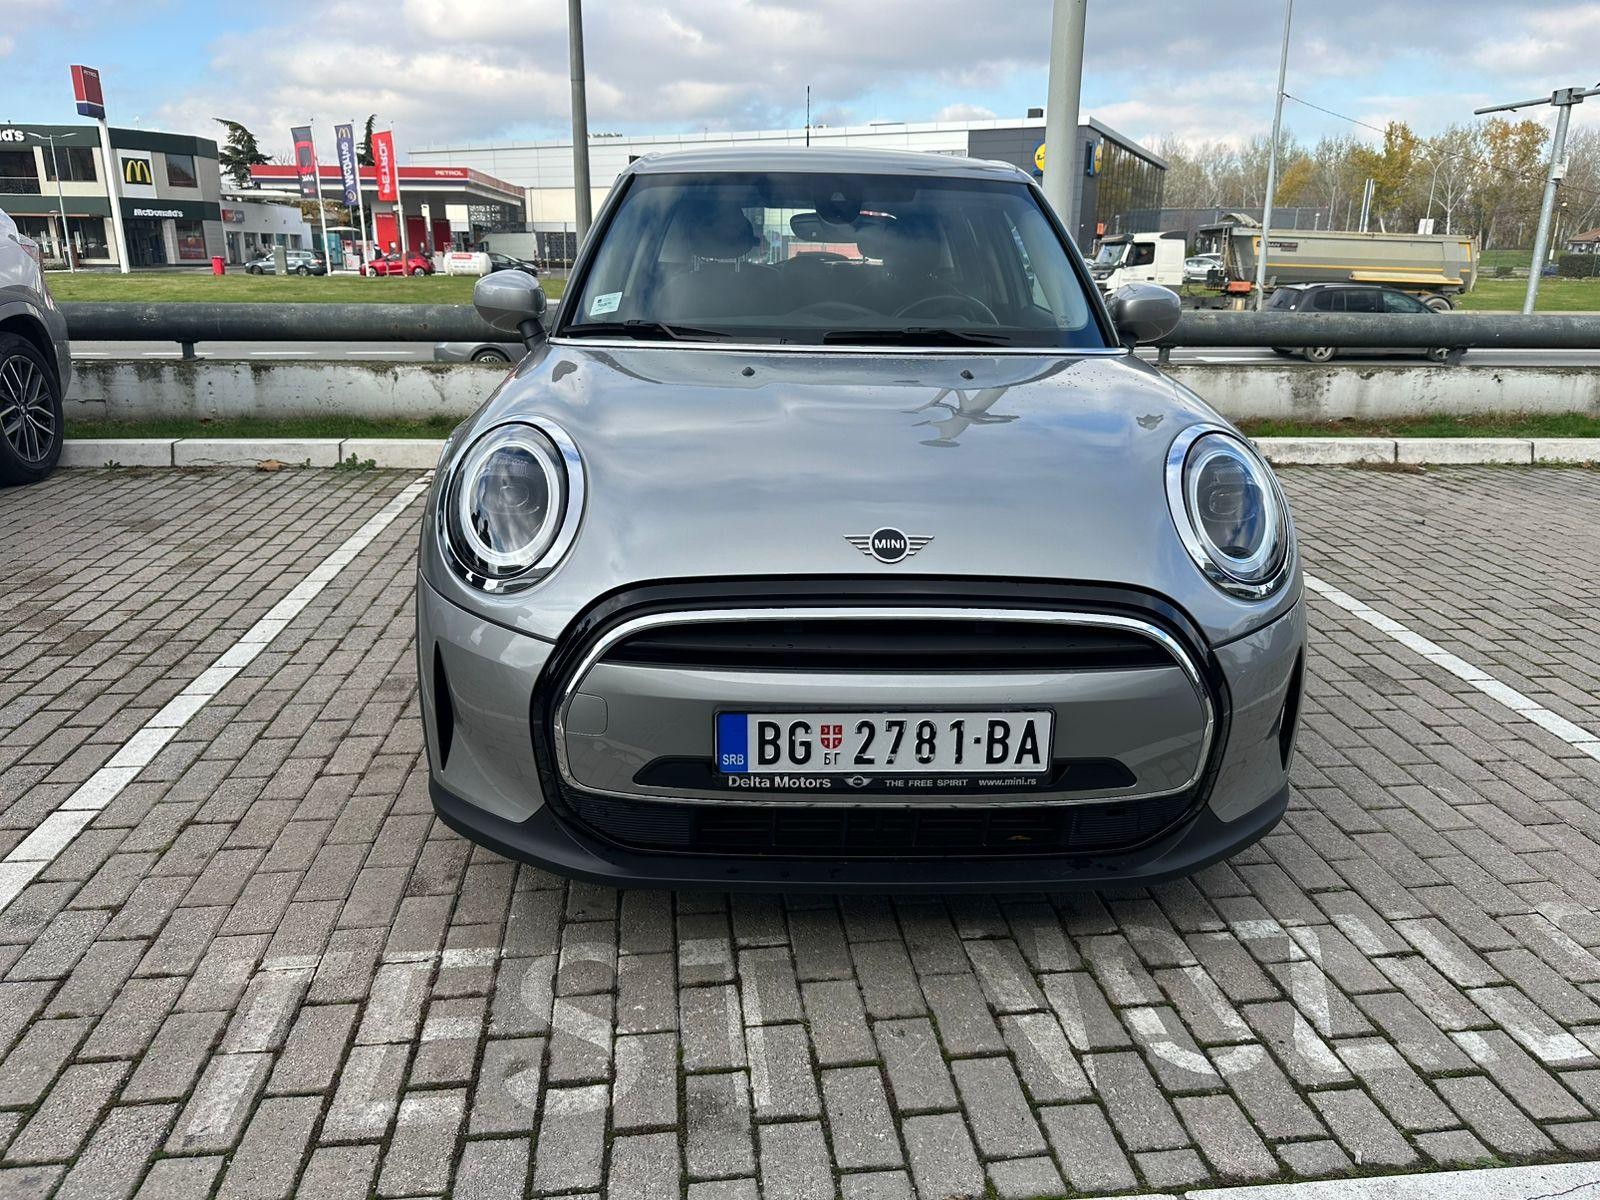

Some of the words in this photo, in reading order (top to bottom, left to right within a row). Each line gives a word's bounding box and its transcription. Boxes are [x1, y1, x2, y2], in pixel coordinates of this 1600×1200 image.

[434, 169, 464, 177] PETROL
[133, 208, 183, 218] McDonald's
[874, 539, 905, 549] MINI
[757, 719, 812, 766] BG
[722, 753, 745, 766] SRB
[823, 752, 840, 765] БГ
[728, 775, 771, 789] Delta
[774, 775, 832, 789] Motors
[884, 779, 905, 788] THE
[908, 779, 933, 788] FREE
[936, 779, 969, 788] SPIRIT
[978, 777, 1037, 787] www.mini.rs
